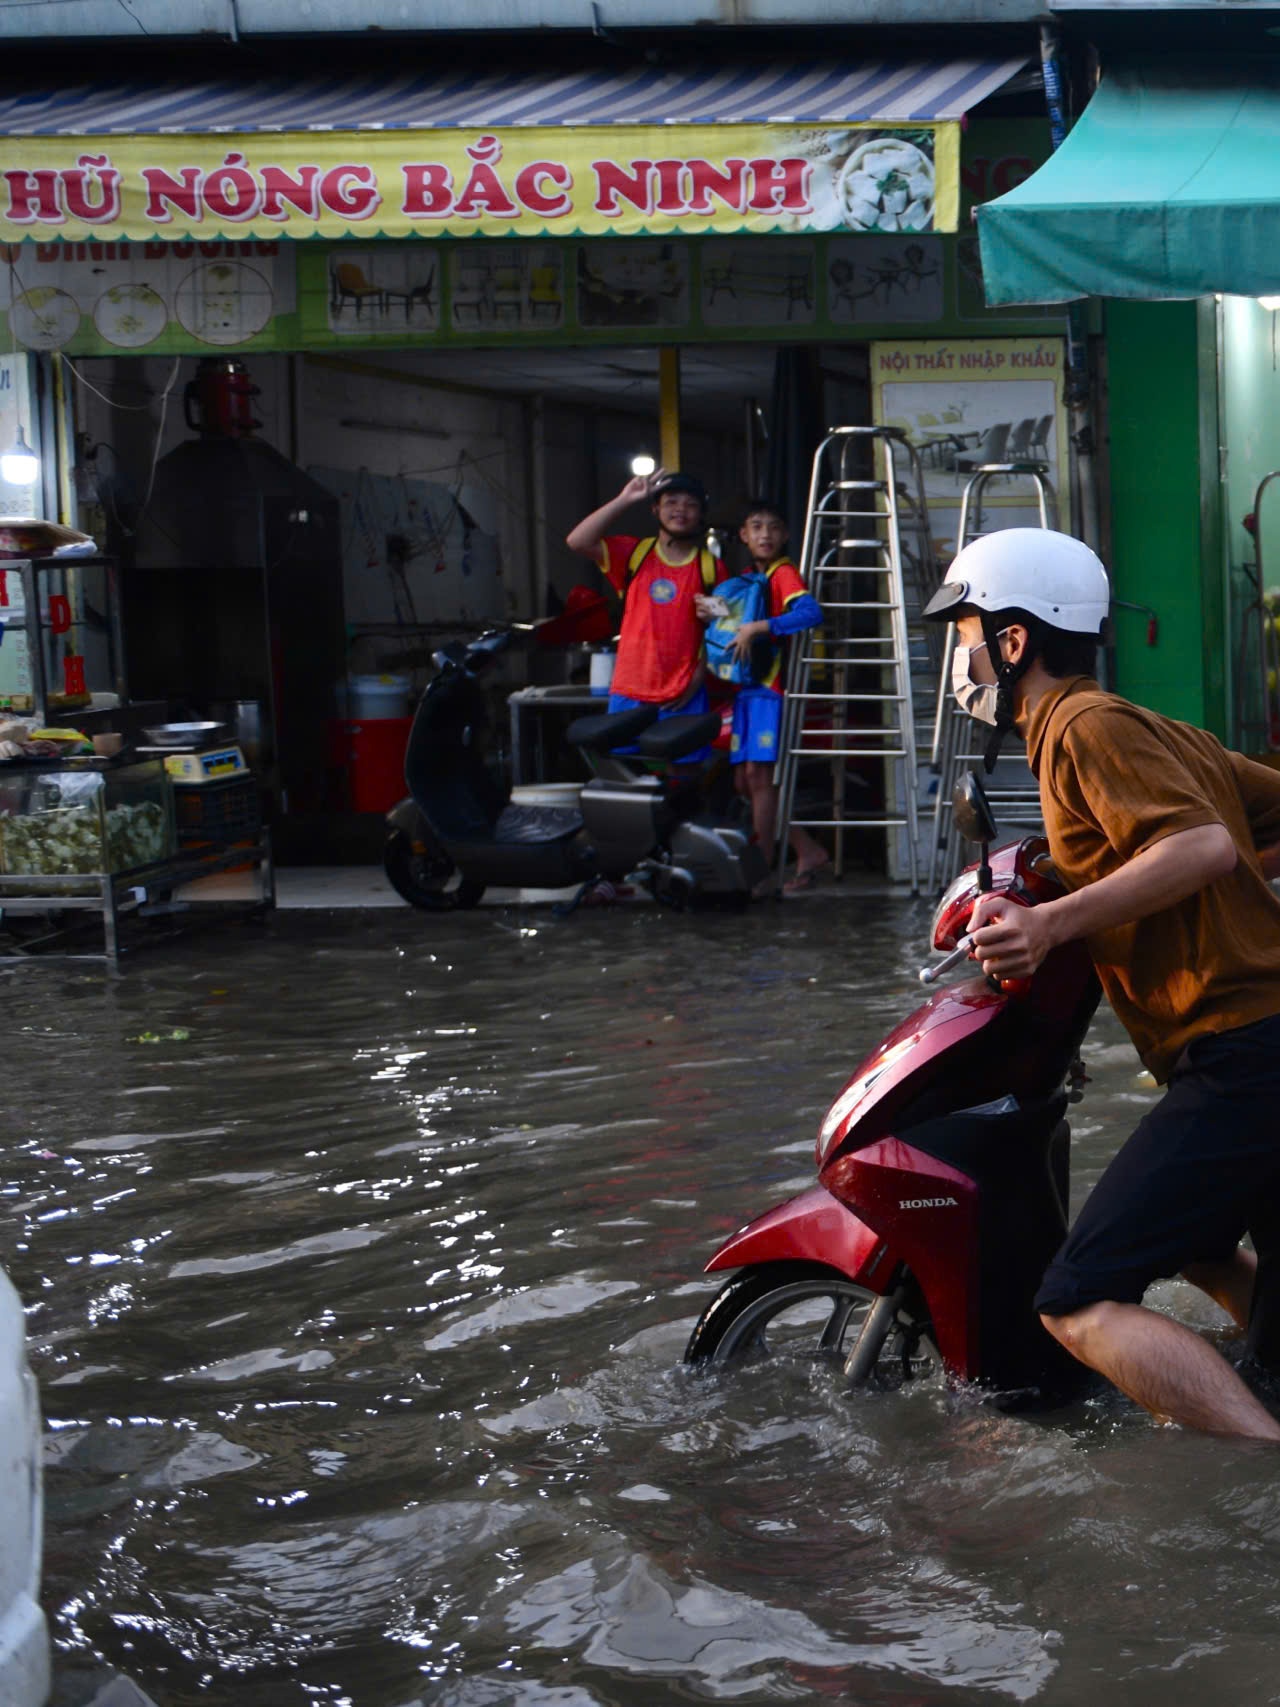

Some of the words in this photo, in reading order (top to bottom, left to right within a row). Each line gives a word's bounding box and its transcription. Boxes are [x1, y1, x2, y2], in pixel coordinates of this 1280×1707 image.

[3, 153, 121, 224] HŨ
[141, 152, 381, 223] NÓNG
[401, 134, 573, 218] BẮC
[592, 158, 813, 217] NINH
[880, 351, 910, 373] NỘI
[915, 348, 955, 369] THẤT
[959, 350, 1005, 373] NHẬP
[899, 1197, 958, 1209] HONDA
